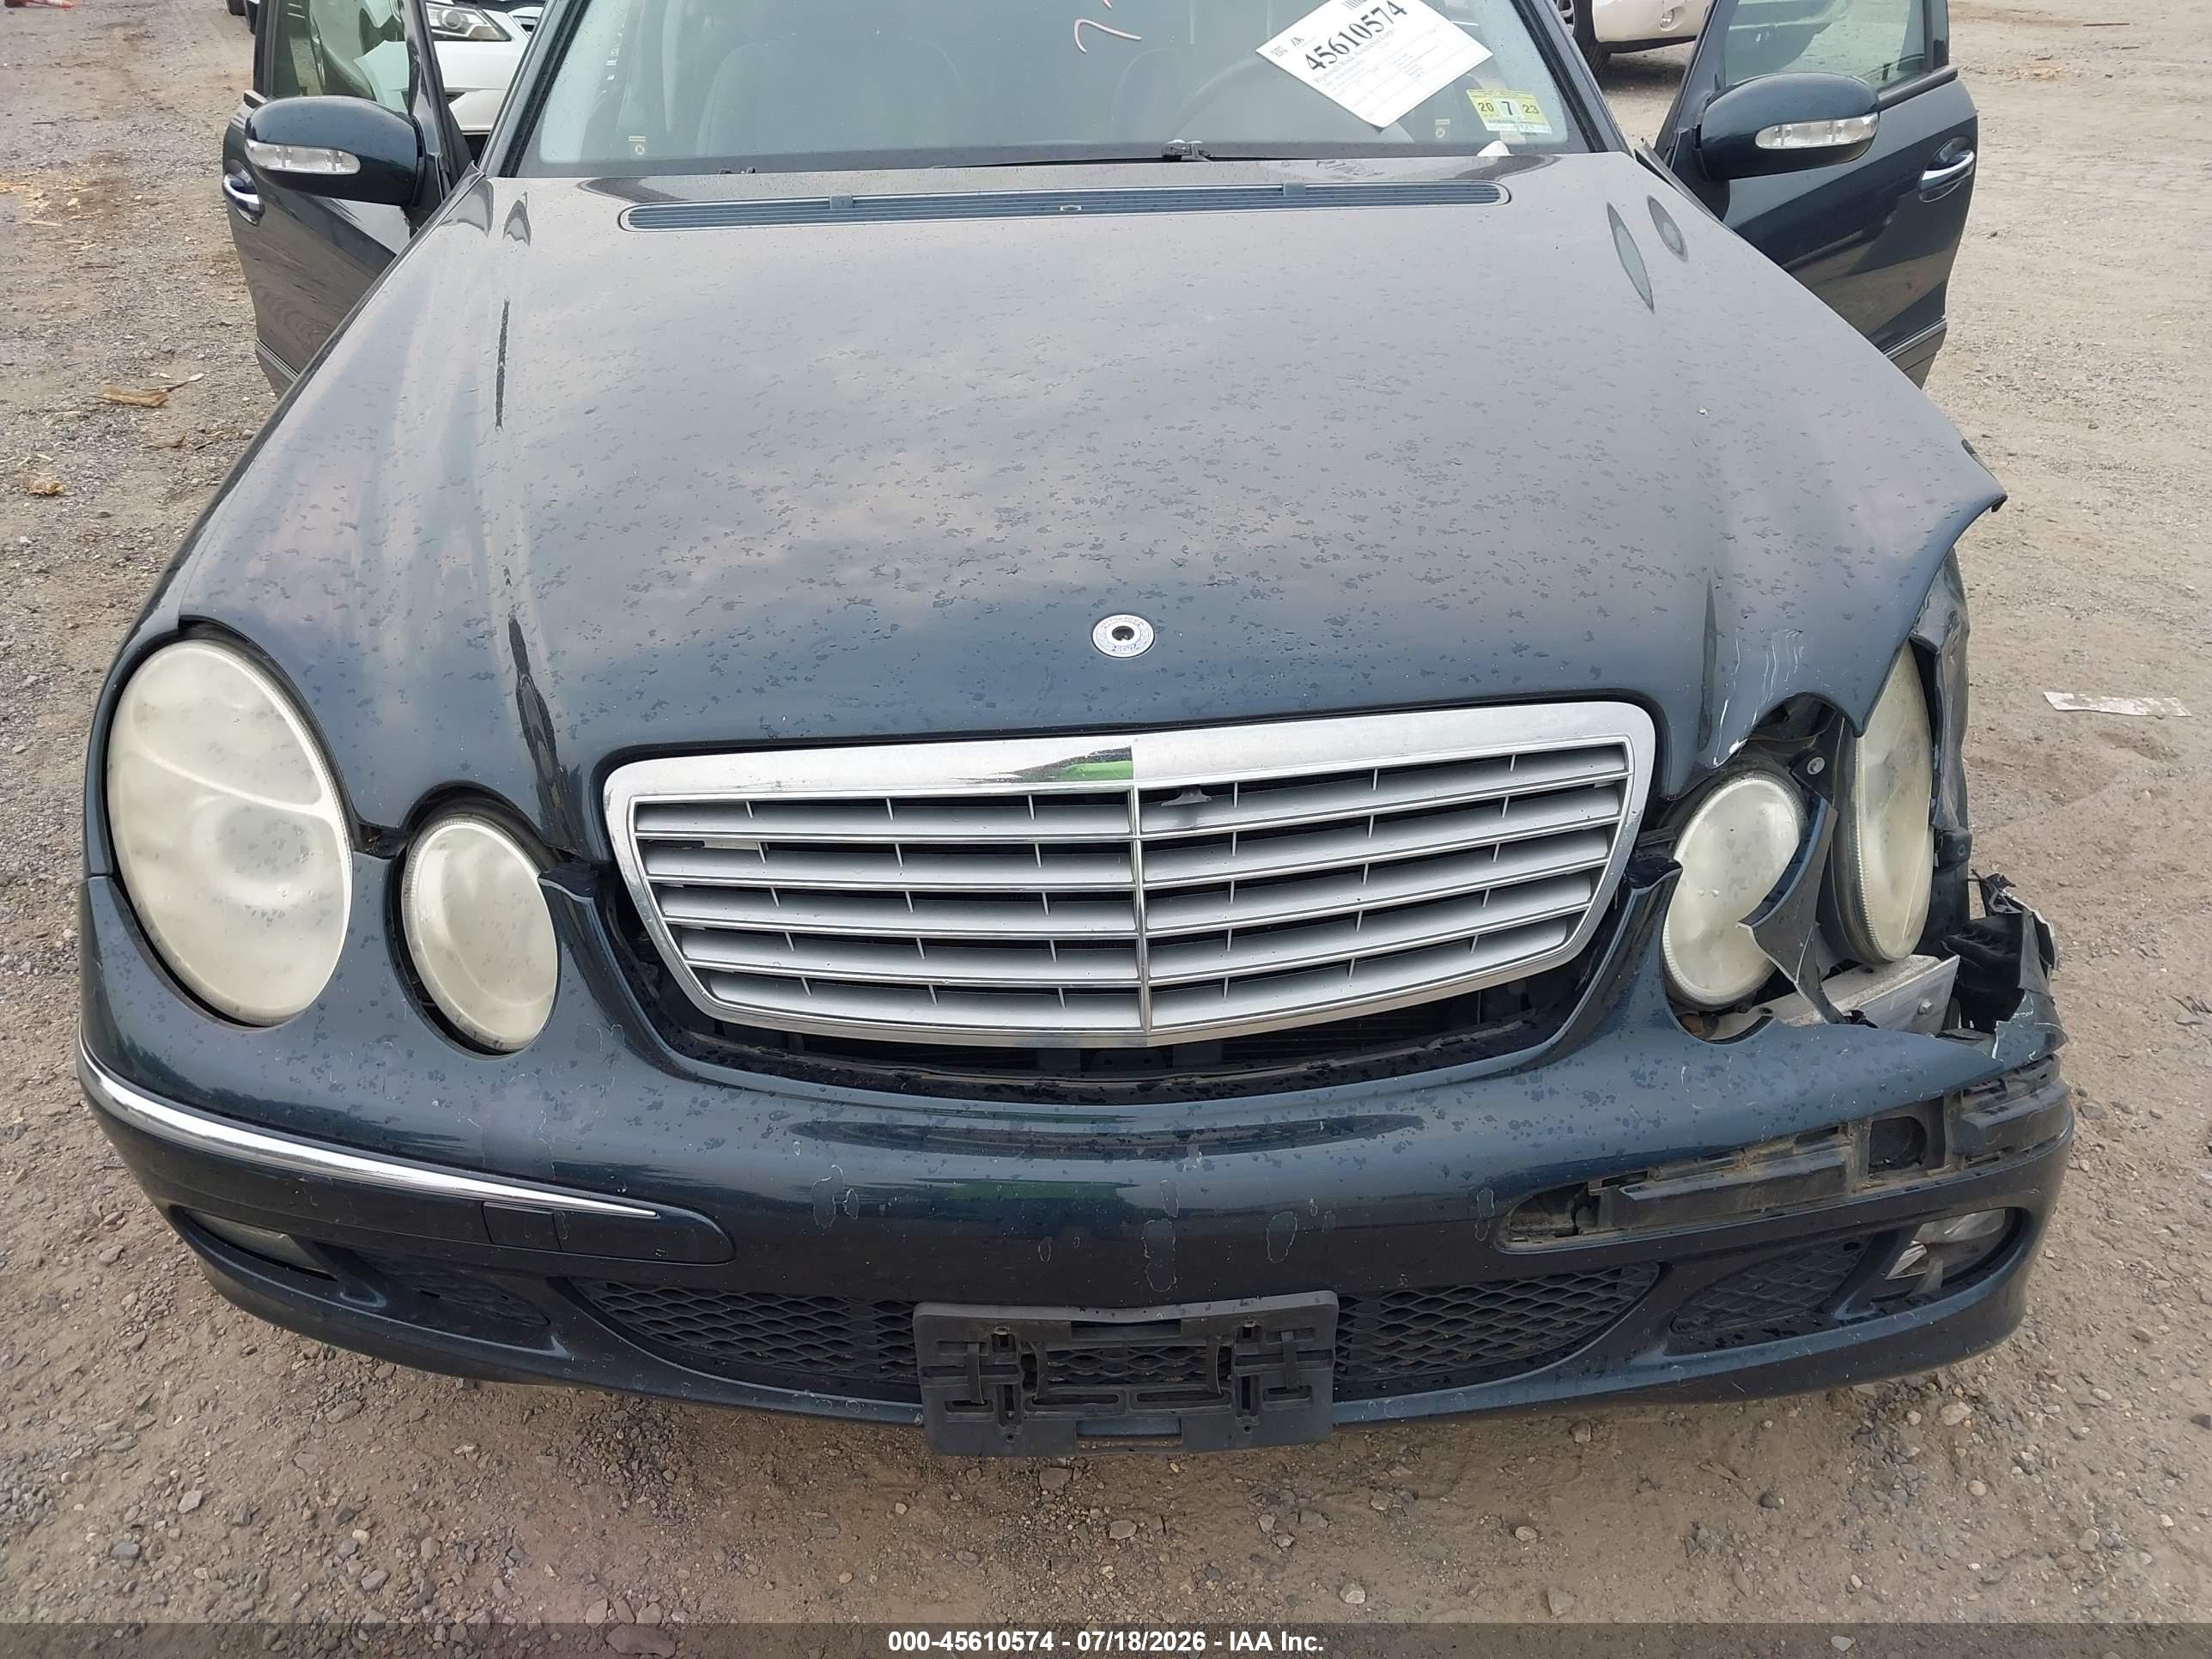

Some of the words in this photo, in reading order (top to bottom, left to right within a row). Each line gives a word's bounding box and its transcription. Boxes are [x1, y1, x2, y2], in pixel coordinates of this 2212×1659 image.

[1304, 0, 1408, 70] 45610574
[1478, 102, 1494, 112] 20
[1502, 100, 1513, 116] 7
[1522, 105, 1540, 114] 23
